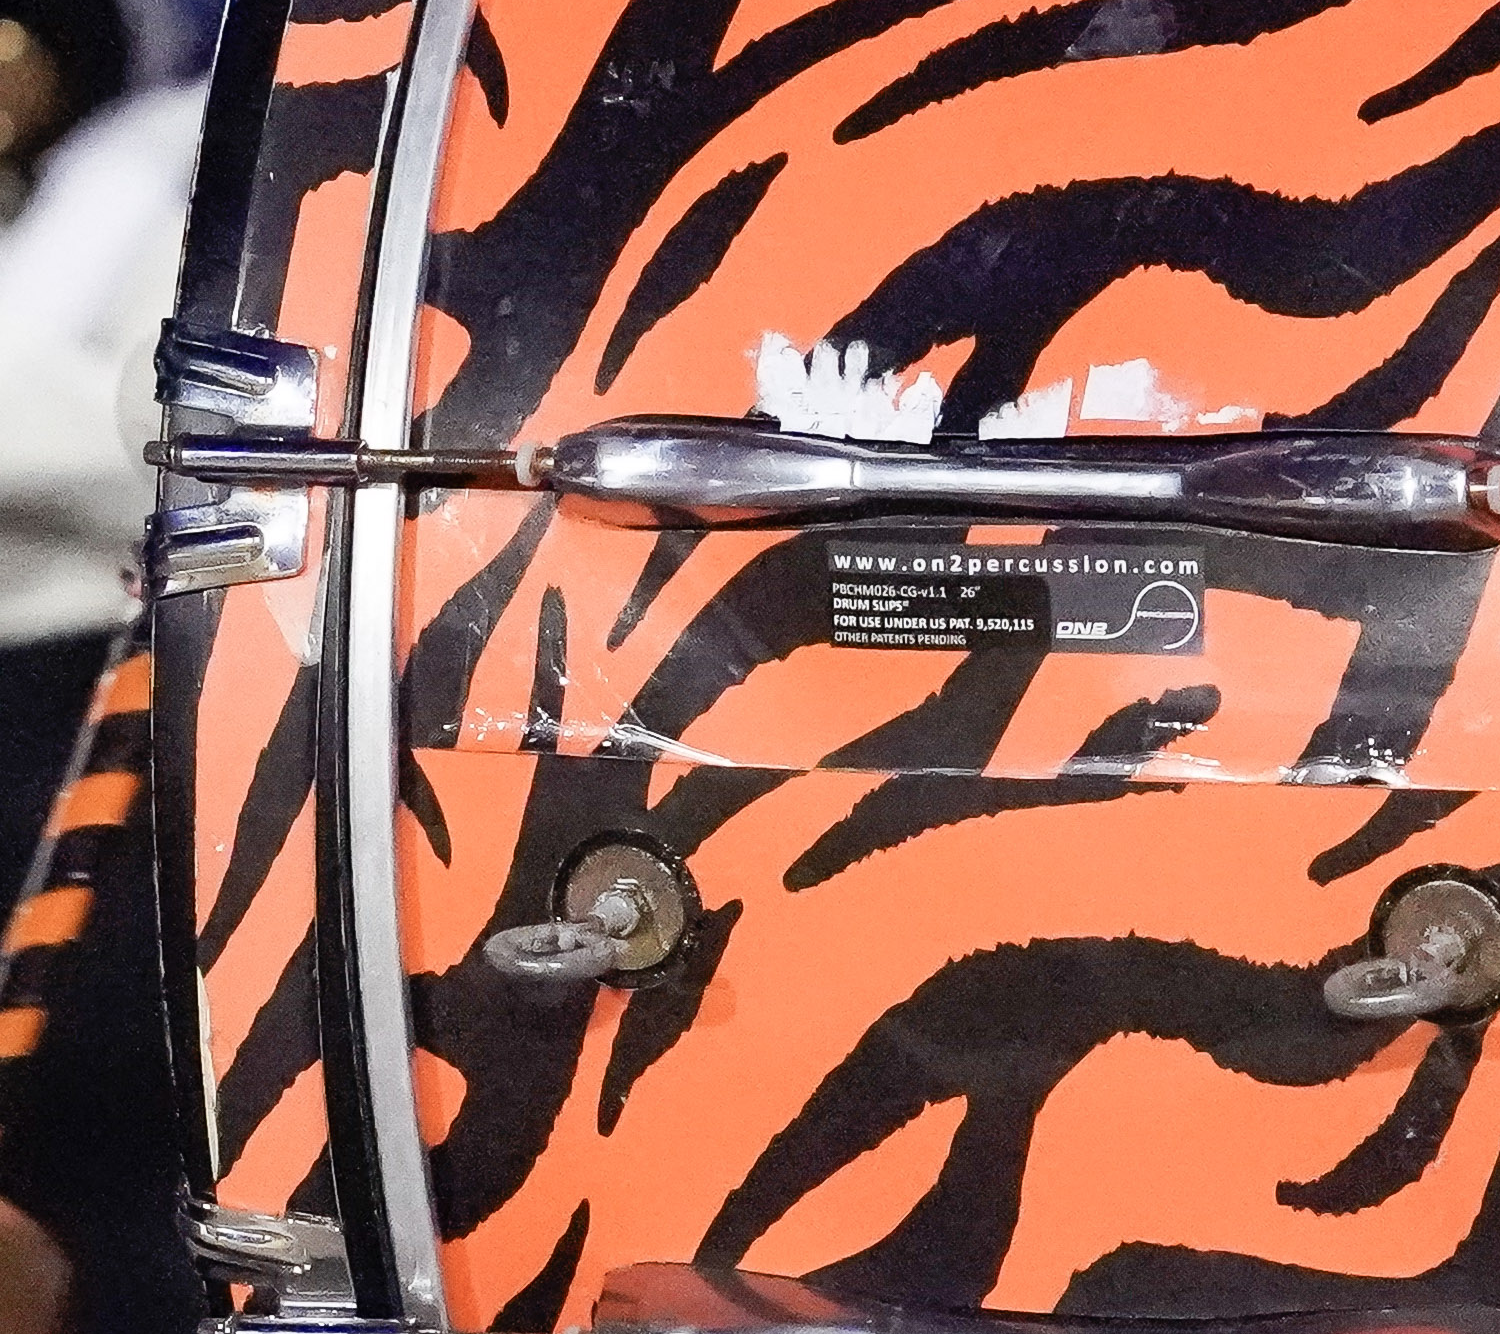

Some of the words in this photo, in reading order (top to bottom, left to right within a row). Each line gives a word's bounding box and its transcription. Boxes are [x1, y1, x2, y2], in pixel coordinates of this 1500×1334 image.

[833, 554, 1199, 575] www.on2percussion.com
[833, 598, 869, 611] DRUM
[833, 615, 857, 627] FOR
[859, 616, 881, 628] USE
[885, 617, 927, 629] UNDER
[929, 618, 947, 629] US
[949, 618, 973, 630] PAT.
[976, 618, 1035, 632] 9,520,115
[834, 631, 869, 642] OTHER
[871, 632, 916, 644] PATENTS
[917, 633, 967, 645] PENDING
